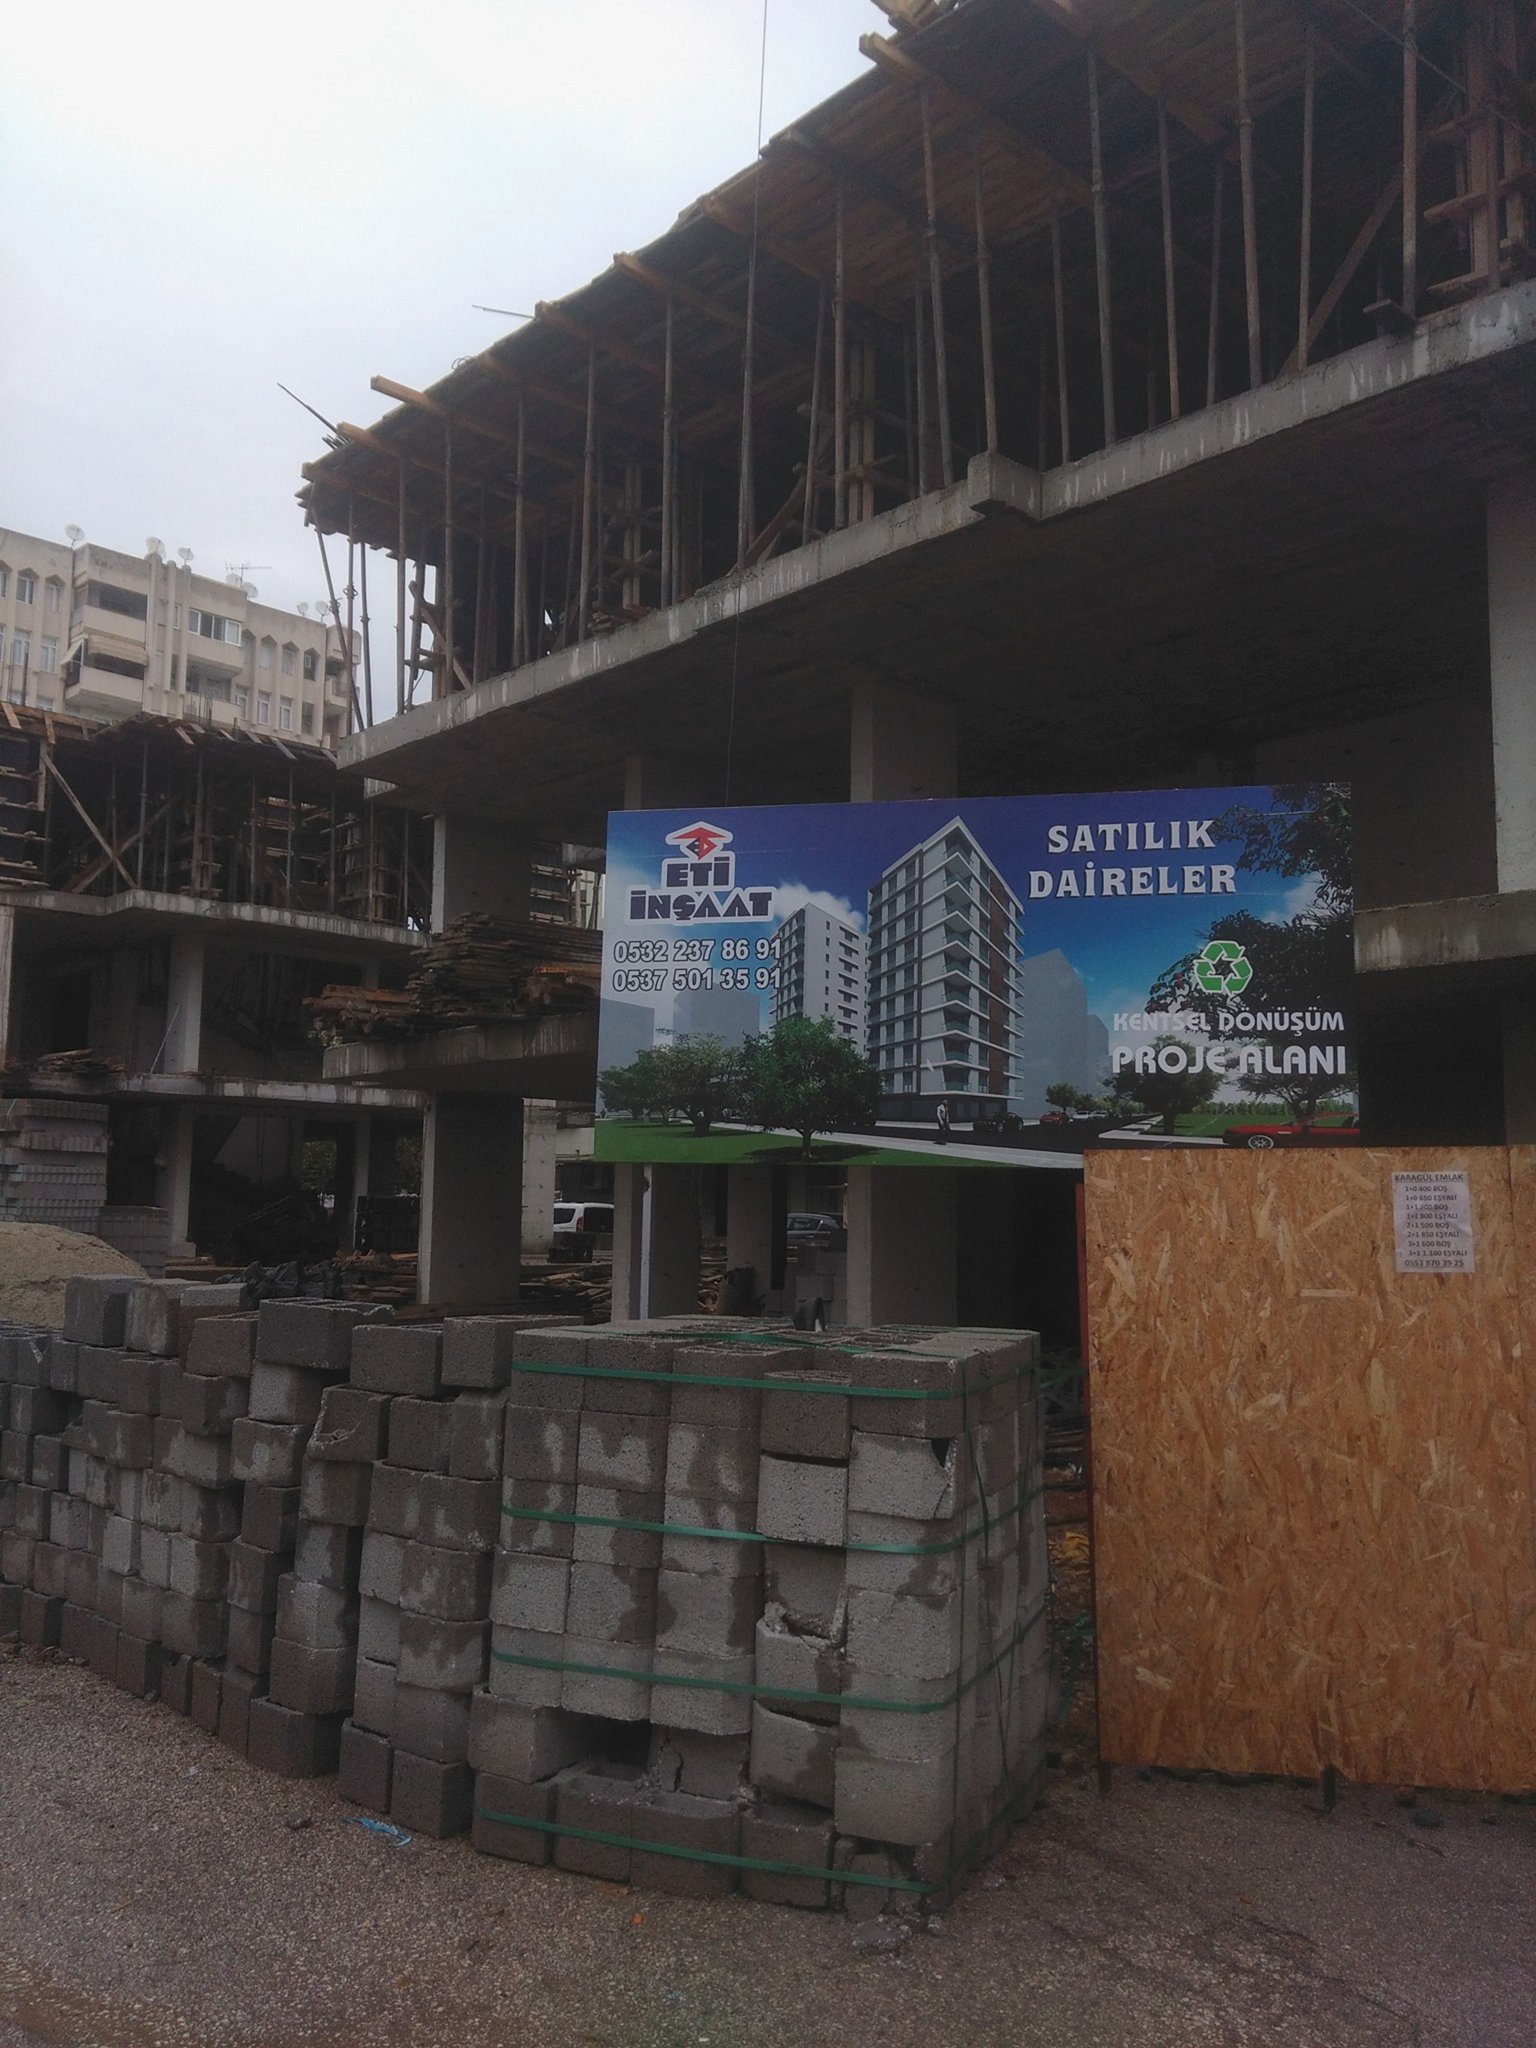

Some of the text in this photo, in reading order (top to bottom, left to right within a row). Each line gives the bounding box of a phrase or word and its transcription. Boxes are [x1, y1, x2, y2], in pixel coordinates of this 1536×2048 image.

[1047, 819, 1217, 853] SATILIK
[666, 856, 730, 887] ETİ
[1028, 861, 1237, 898] DAİRELER
[630, 890, 772, 921] İNŞAAT
[613, 937, 782, 963] 0532 237 86 91
[612, 967, 782, 991] 0537 501 35 91
[1113, 1007, 1345, 1037] KENTSEL DÖNÜŞÜM
[1112, 1046, 1346, 1075] PROJE ALANI
[1395, 1173, 1463, 1182] KARAGÜL EMLAK
[1433, 1185, 1448, 1193] BOŞ
[1436, 1231, 1459, 1239] EŞYALI
